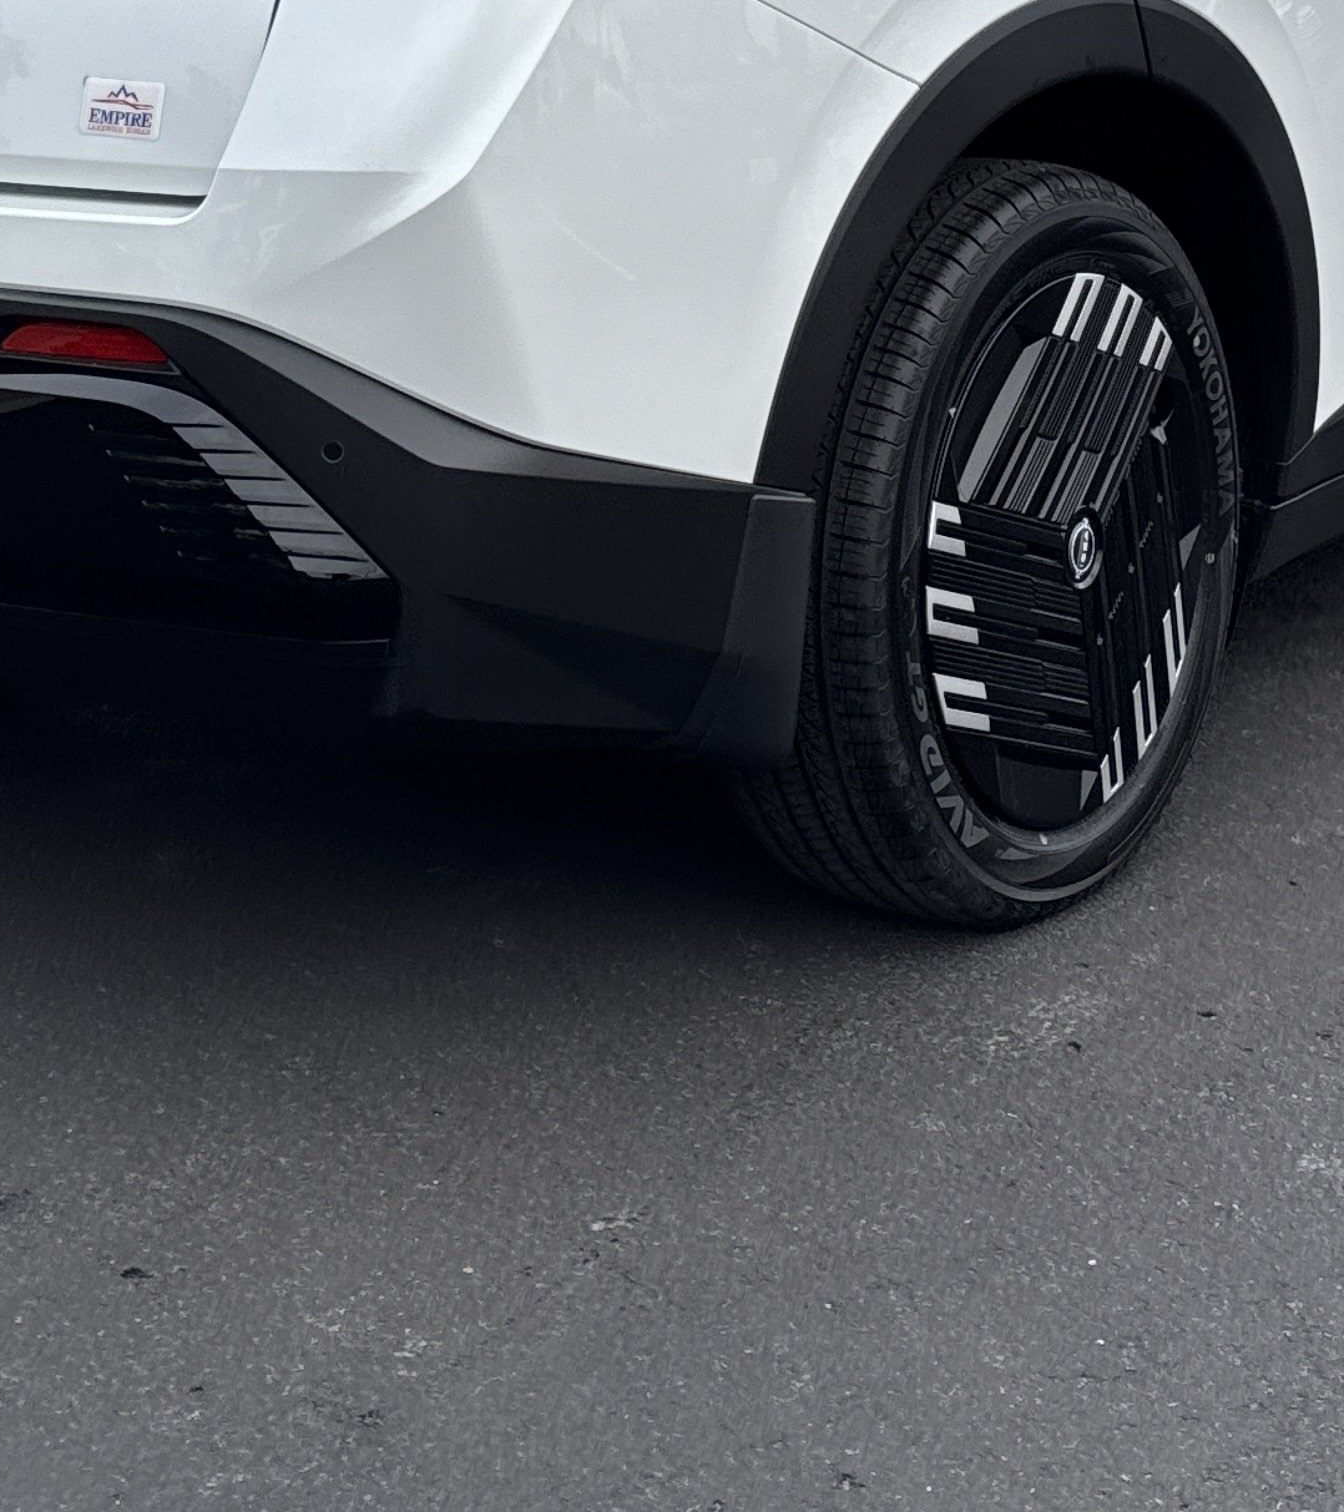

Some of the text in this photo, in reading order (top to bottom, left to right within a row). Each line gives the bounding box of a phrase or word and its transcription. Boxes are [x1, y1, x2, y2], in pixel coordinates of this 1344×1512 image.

[88, 107, 153, 128] EMPIRE
[1186, 305, 1236, 516] YOKOHAMA
[920, 734, 990, 849] AVID
